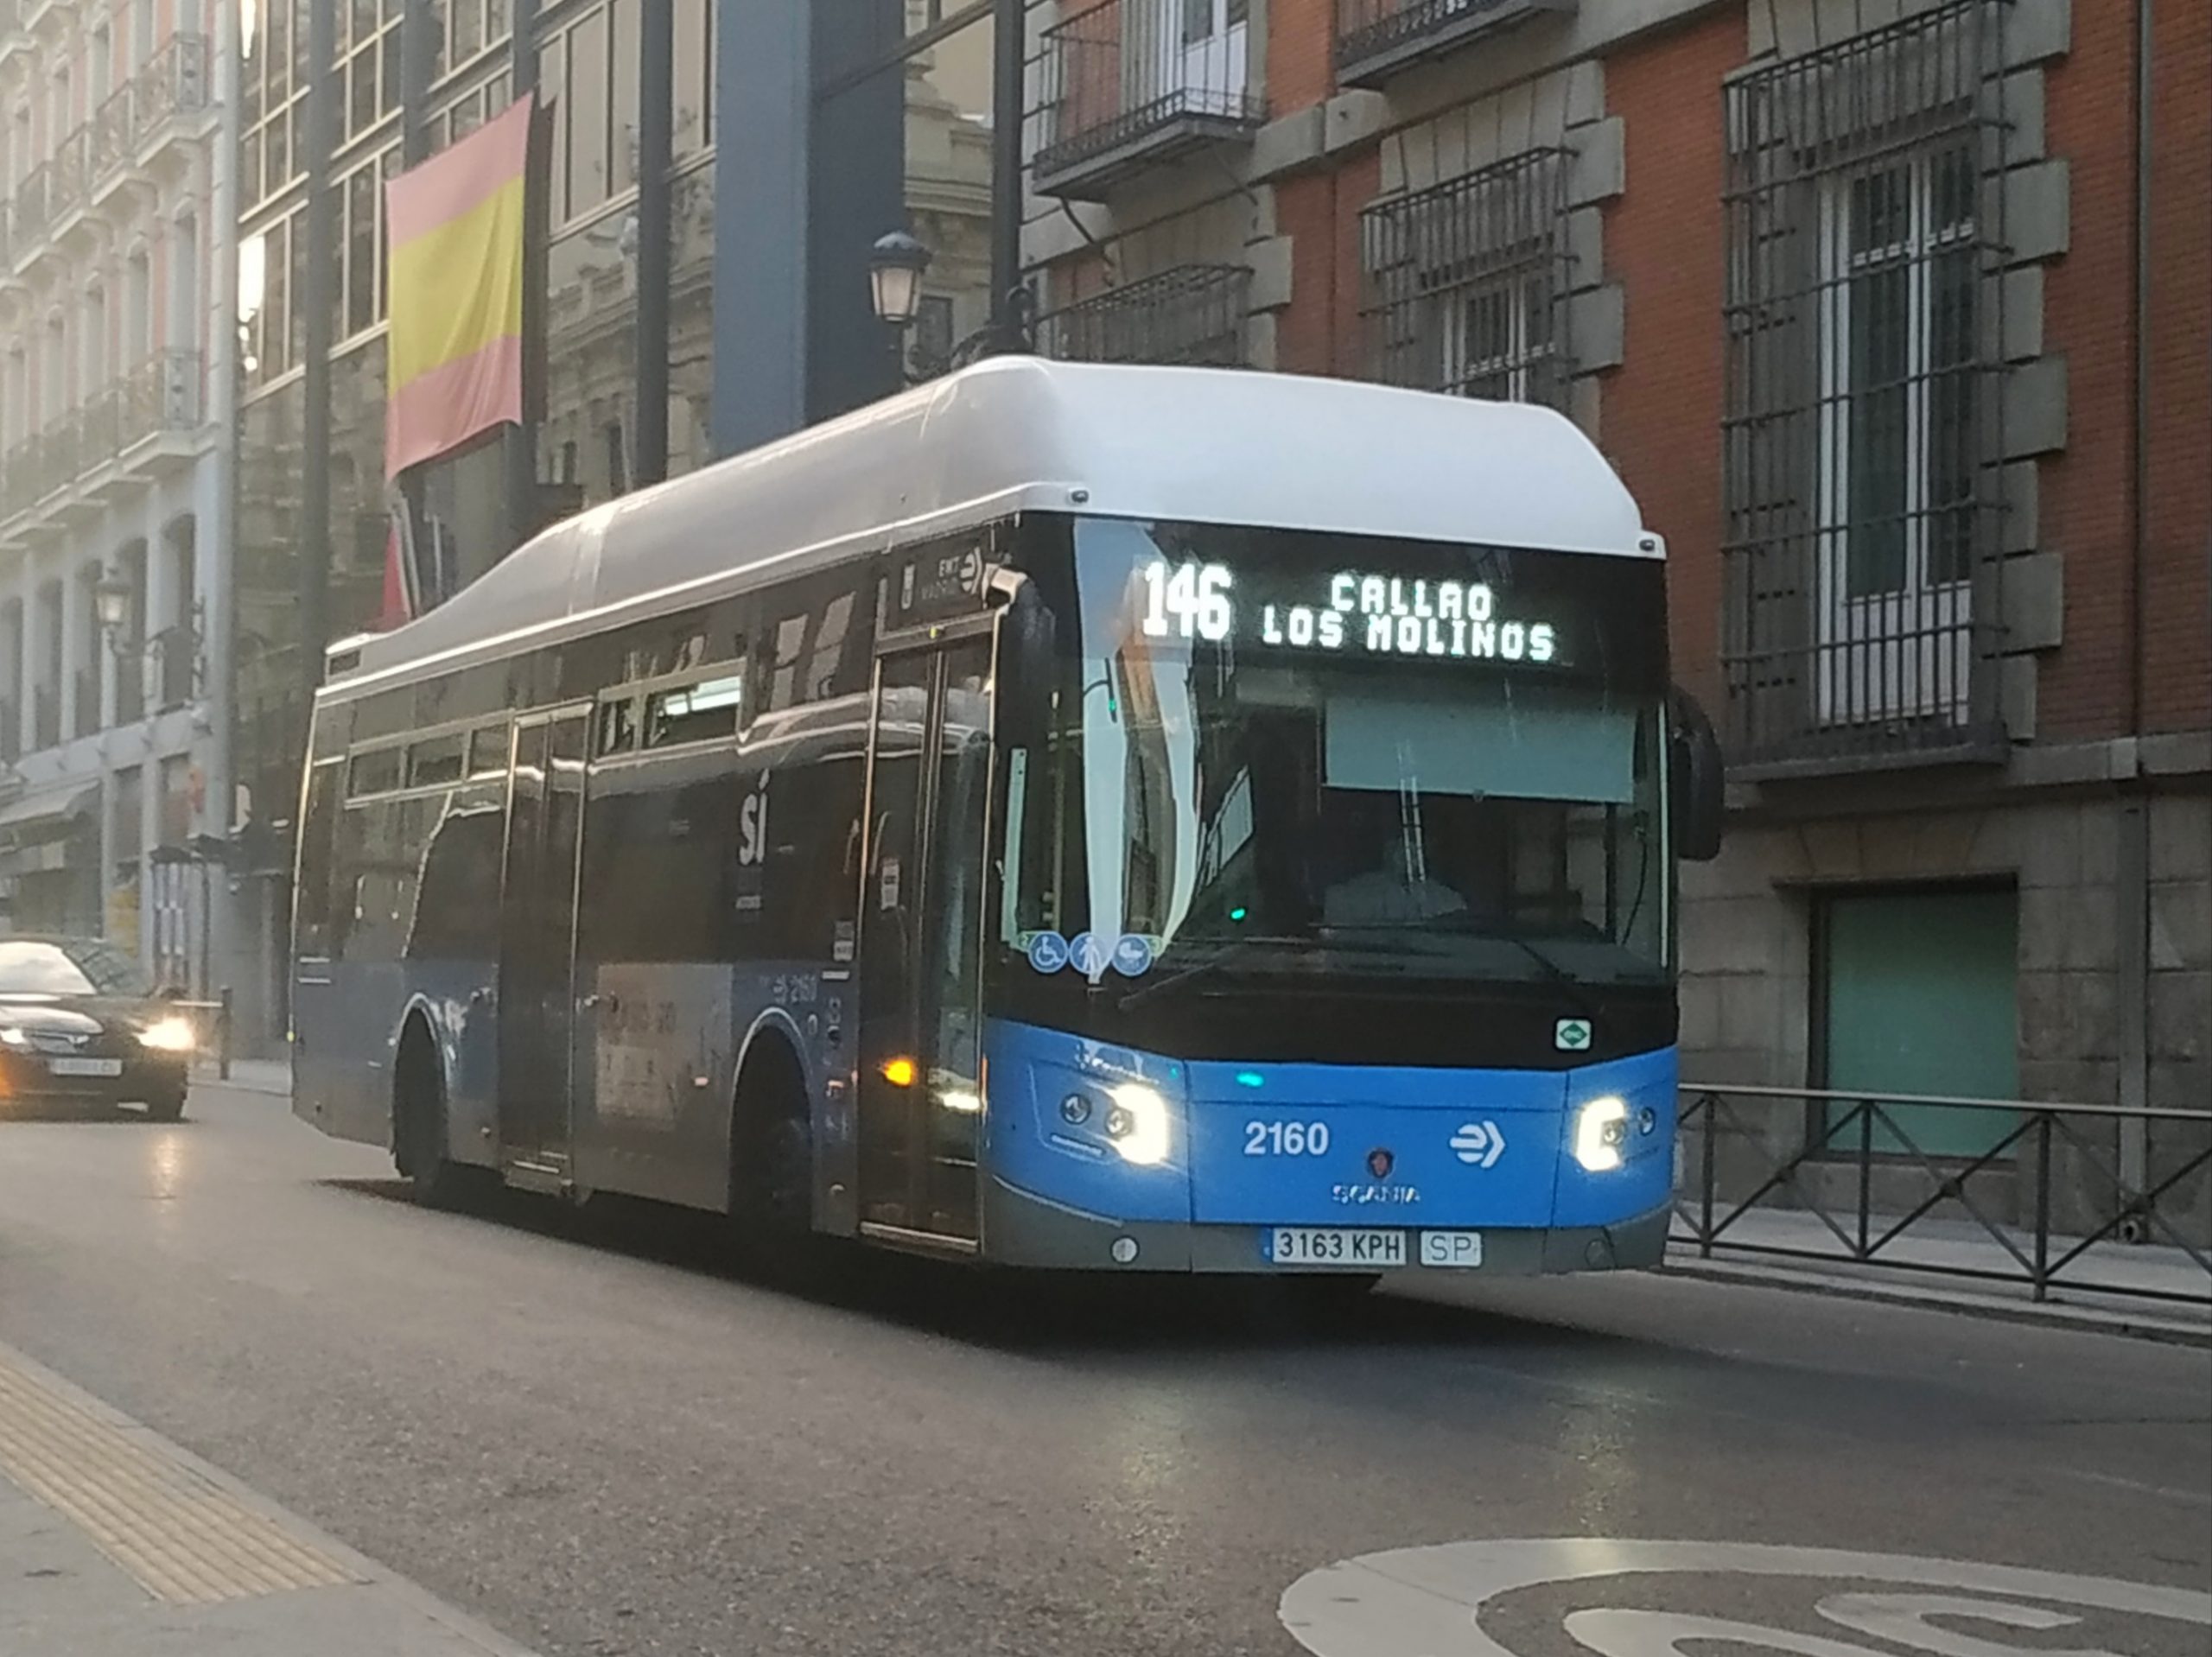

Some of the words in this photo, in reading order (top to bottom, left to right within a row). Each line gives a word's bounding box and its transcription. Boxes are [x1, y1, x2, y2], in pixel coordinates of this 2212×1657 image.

[1143, 562, 1231, 640] 146
[1331, 573, 1492, 621] CALLAO
[1262, 605, 1343, 647] LOS
[1367, 613, 1554, 661] MOLINOS
[1243, 1121, 1329, 1156] 2160
[1332, 1184, 1420, 1204] SCANIA
[1279, 1232, 1343, 1258] 3163
[1352, 1234, 1400, 1260] KPH
[1430, 1235, 1473, 1261] SP
